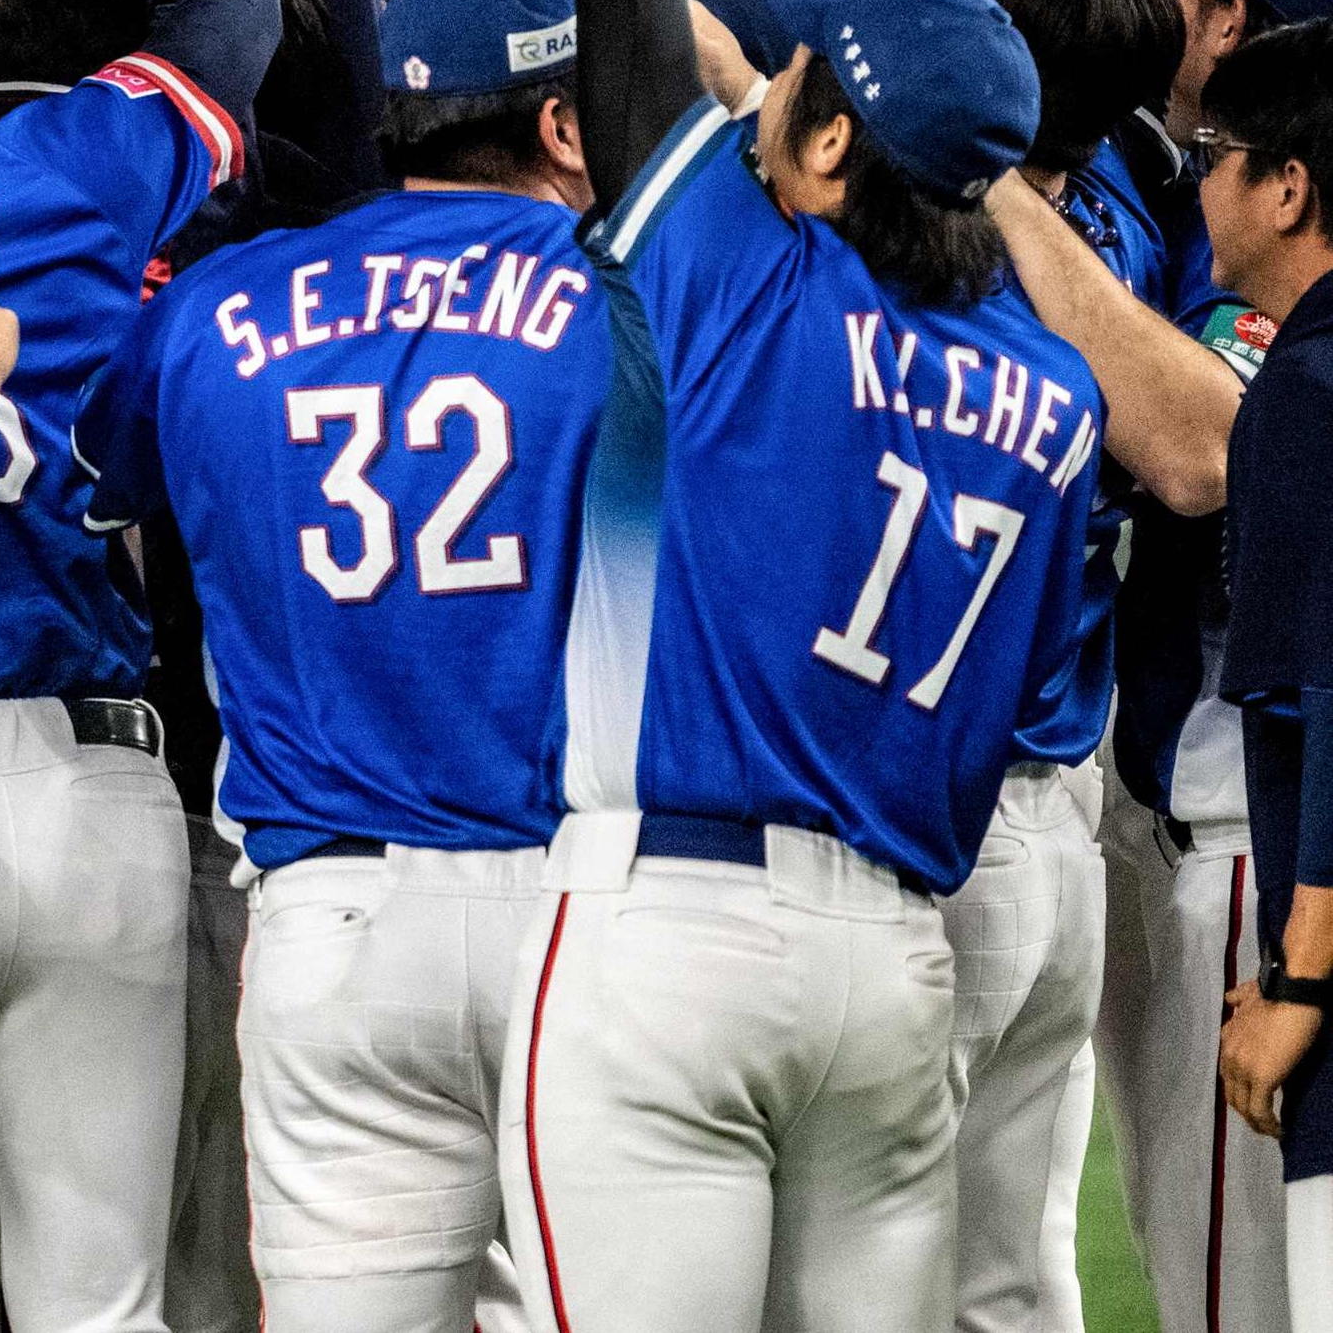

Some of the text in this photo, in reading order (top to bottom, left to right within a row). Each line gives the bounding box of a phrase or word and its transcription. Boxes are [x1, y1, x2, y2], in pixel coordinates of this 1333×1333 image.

[214, 244, 587, 378] S.E.TSENG
[285, 373, 527, 603] 32
[812, 452, 1025, 711] 17
